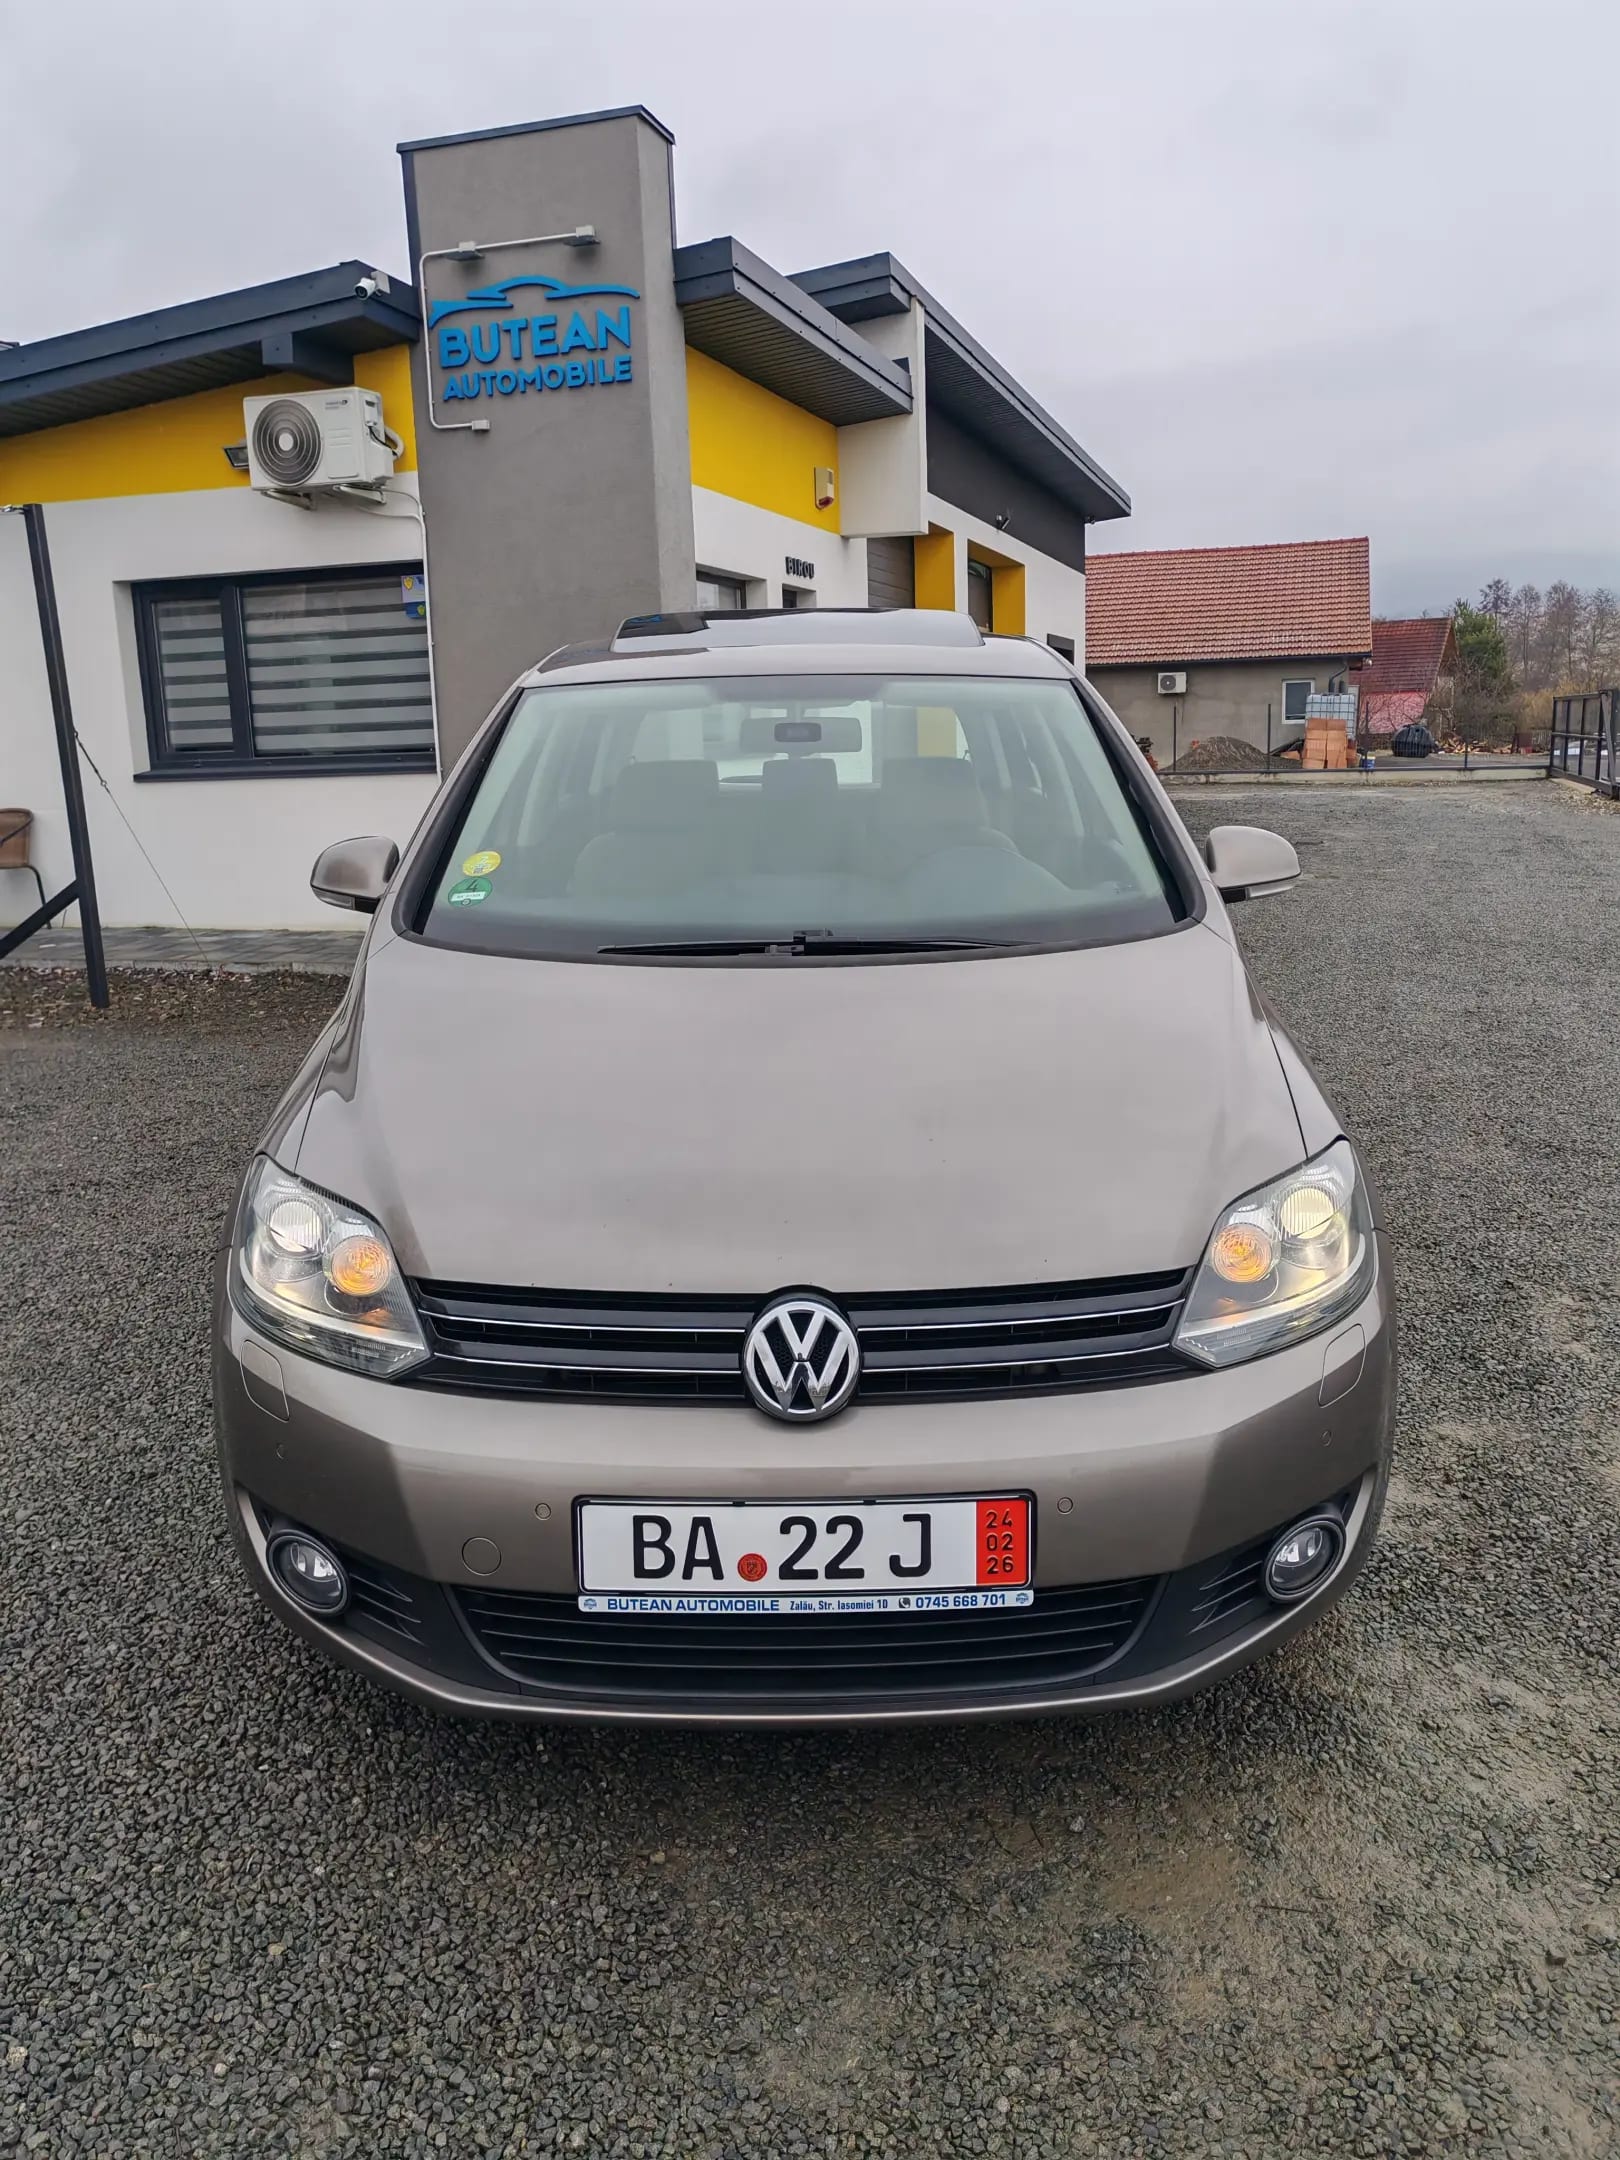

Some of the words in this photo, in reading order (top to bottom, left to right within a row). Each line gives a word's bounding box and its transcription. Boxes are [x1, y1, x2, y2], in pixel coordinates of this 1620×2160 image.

[439, 306, 631, 368] BUTEAN
[443, 355, 632, 401] AUTOMOBILE
[785, 556, 815, 579] BIROU
[465, 878, 478, 892] 4
[985, 1508, 1014, 1529] 24
[632, 1514, 725, 1581] BA
[778, 1514, 866, 1580] 22
[888, 1513, 932, 1578] J
[985, 1531, 1015, 1551] 02
[986, 1555, 1016, 1575] 26
[607, 1598, 673, 1611] BUTEAN
[675, 1599, 780, 1612] AUTOMOBILE
[818, 1600, 835, 1611] Str.
[837, 1599, 874, 1610] Iasomiei
[877, 1598, 889, 1609] 10
[915, 1595, 949, 1609] 0745
[953, 1595, 979, 1608] 668
[981, 1593, 1006, 1607] 701
